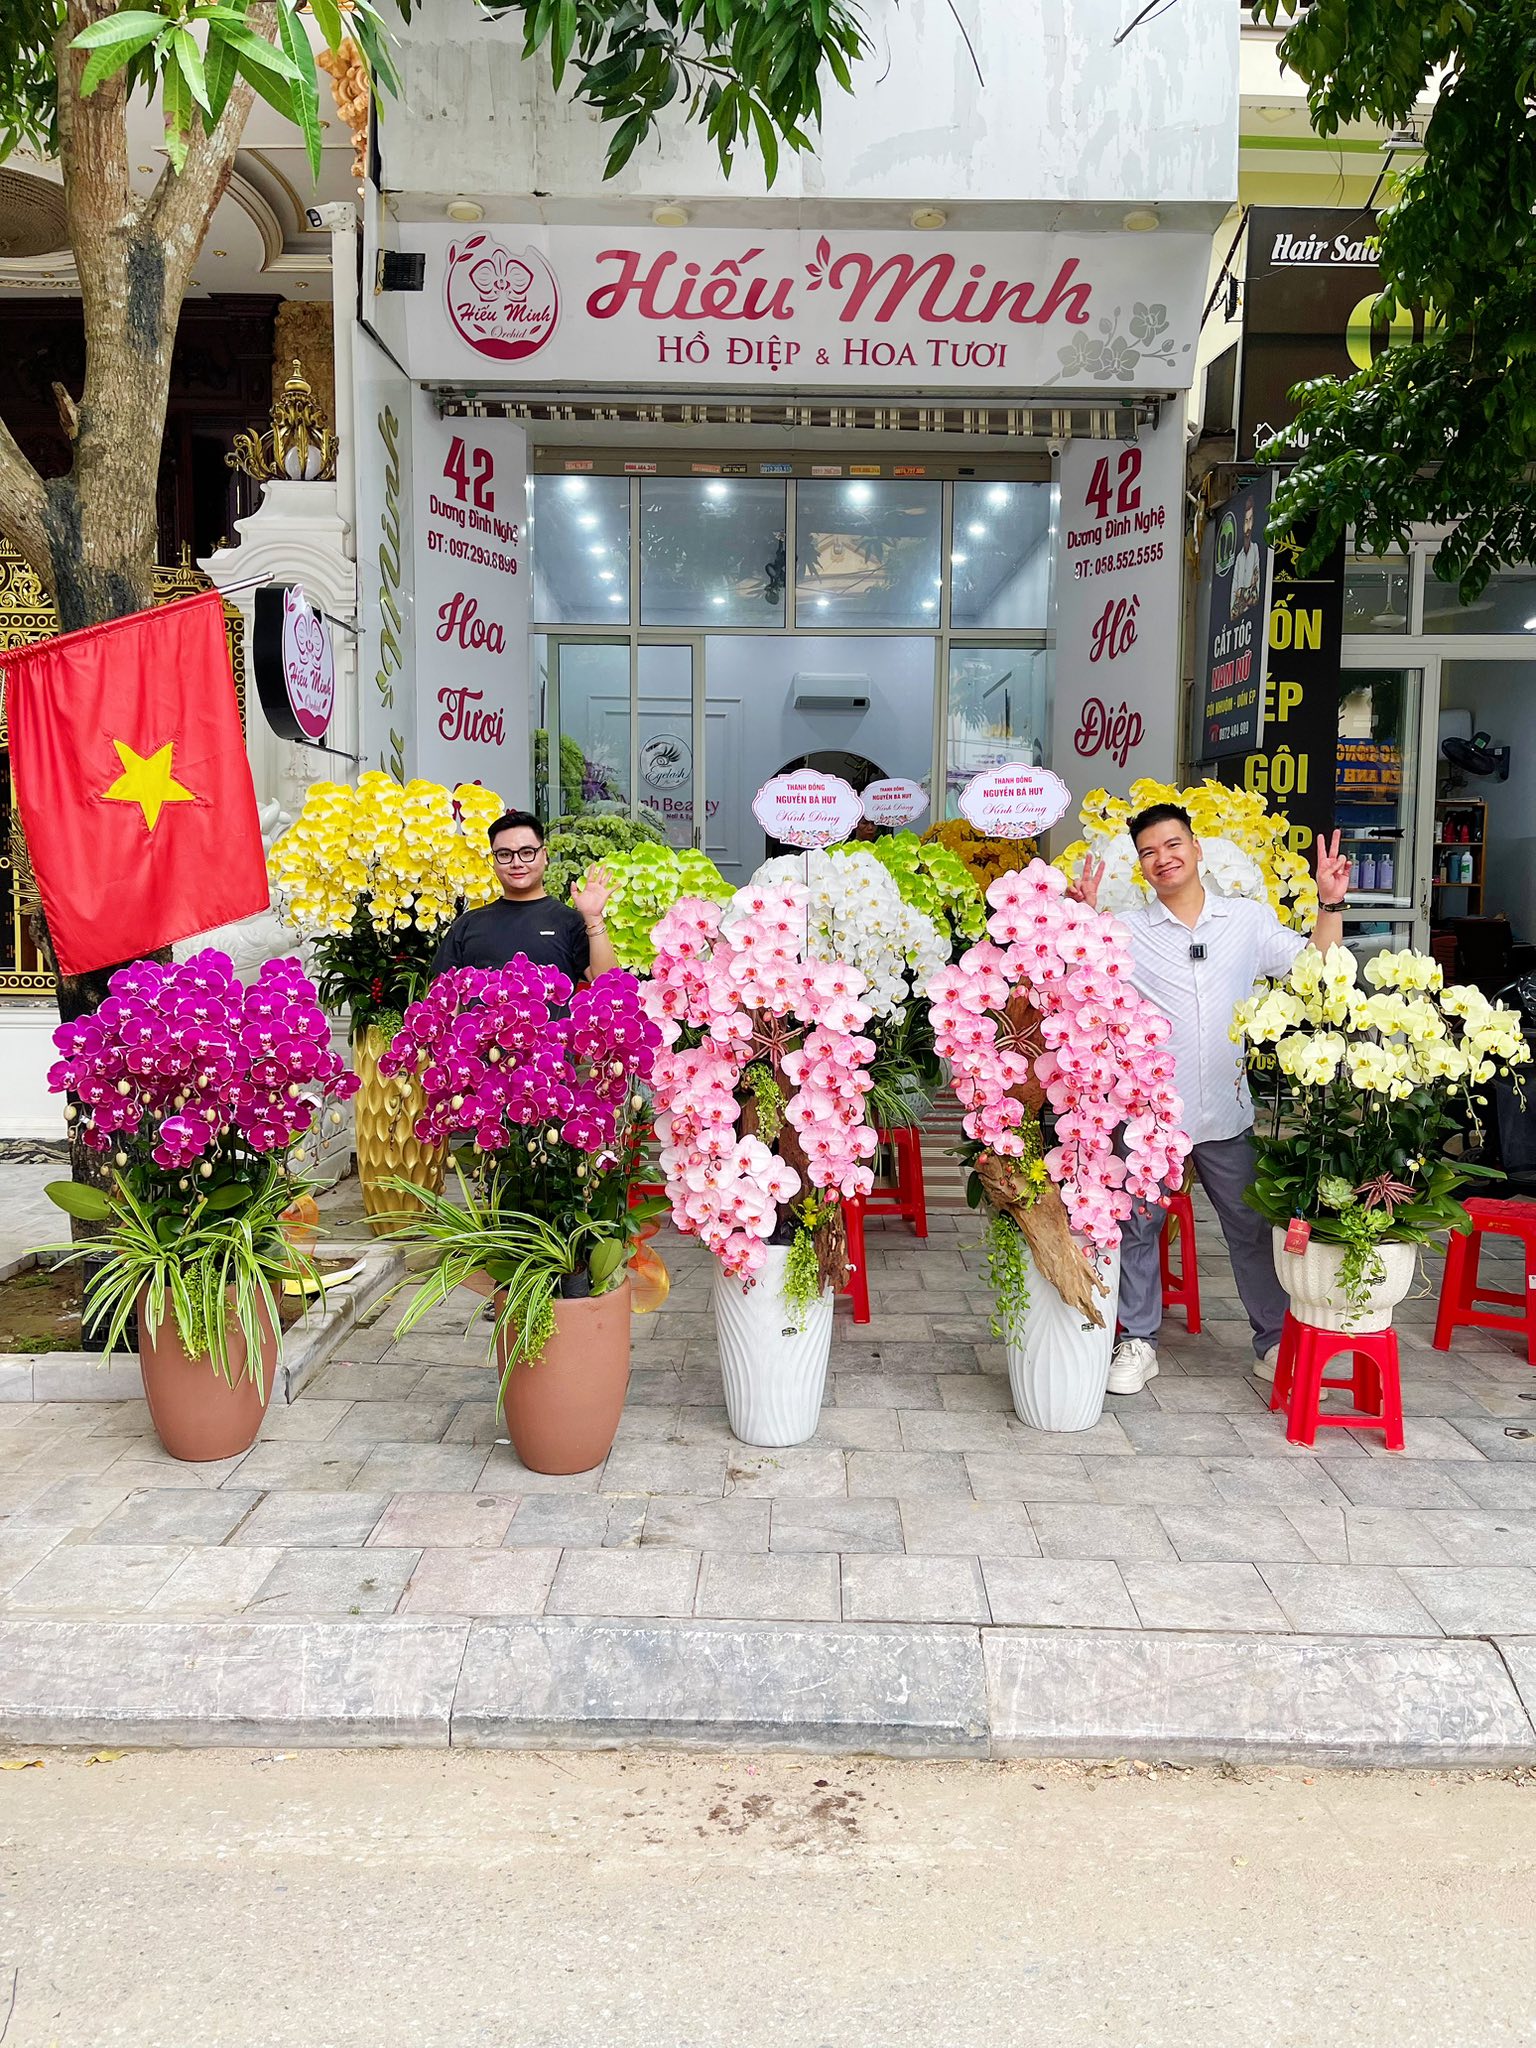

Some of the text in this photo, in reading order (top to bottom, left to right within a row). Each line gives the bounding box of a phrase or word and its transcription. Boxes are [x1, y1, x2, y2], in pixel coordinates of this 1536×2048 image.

[1271, 233, 1328, 262] Hair
[586, 248, 1092, 324] Hiếu Minh
[457, 303, 551, 322] Hiếu Minh
[491, 325, 528, 339] Orchid
[816, 348, 830, 365] &
[843, 338, 918, 366] HOA
[443, 435, 495, 513] 42
[1085, 447, 1142, 520] 42
[430, 494, 518, 547] Dương Đình Nghệ
[1067, 505, 1166, 549] Dương Đình Nghệ
[1095, 542, 1164, 575] 058.552.5555
[436, 591, 506, 655] Hoa
[1089, 593, 1141, 663] Hồ
[1213, 618, 1252, 659] CẮT TÓC
[1268, 594, 1323, 650] ỐN
[288, 661, 332, 695] Hiếu Minh
[1211, 649, 1253, 692] NAM NỮ
[438, 687, 506, 746] Tươi
[1074, 697, 1146, 768] Điệp
[645, 765, 686, 785] Eyelash
[995, 777, 1014, 785] THANH
[1028, 787, 1044, 796] HUY
[1243, 745, 1309, 803] GỘI
[663, 798, 720, 817] Beaty
[821, 796, 837, 804] HUY
